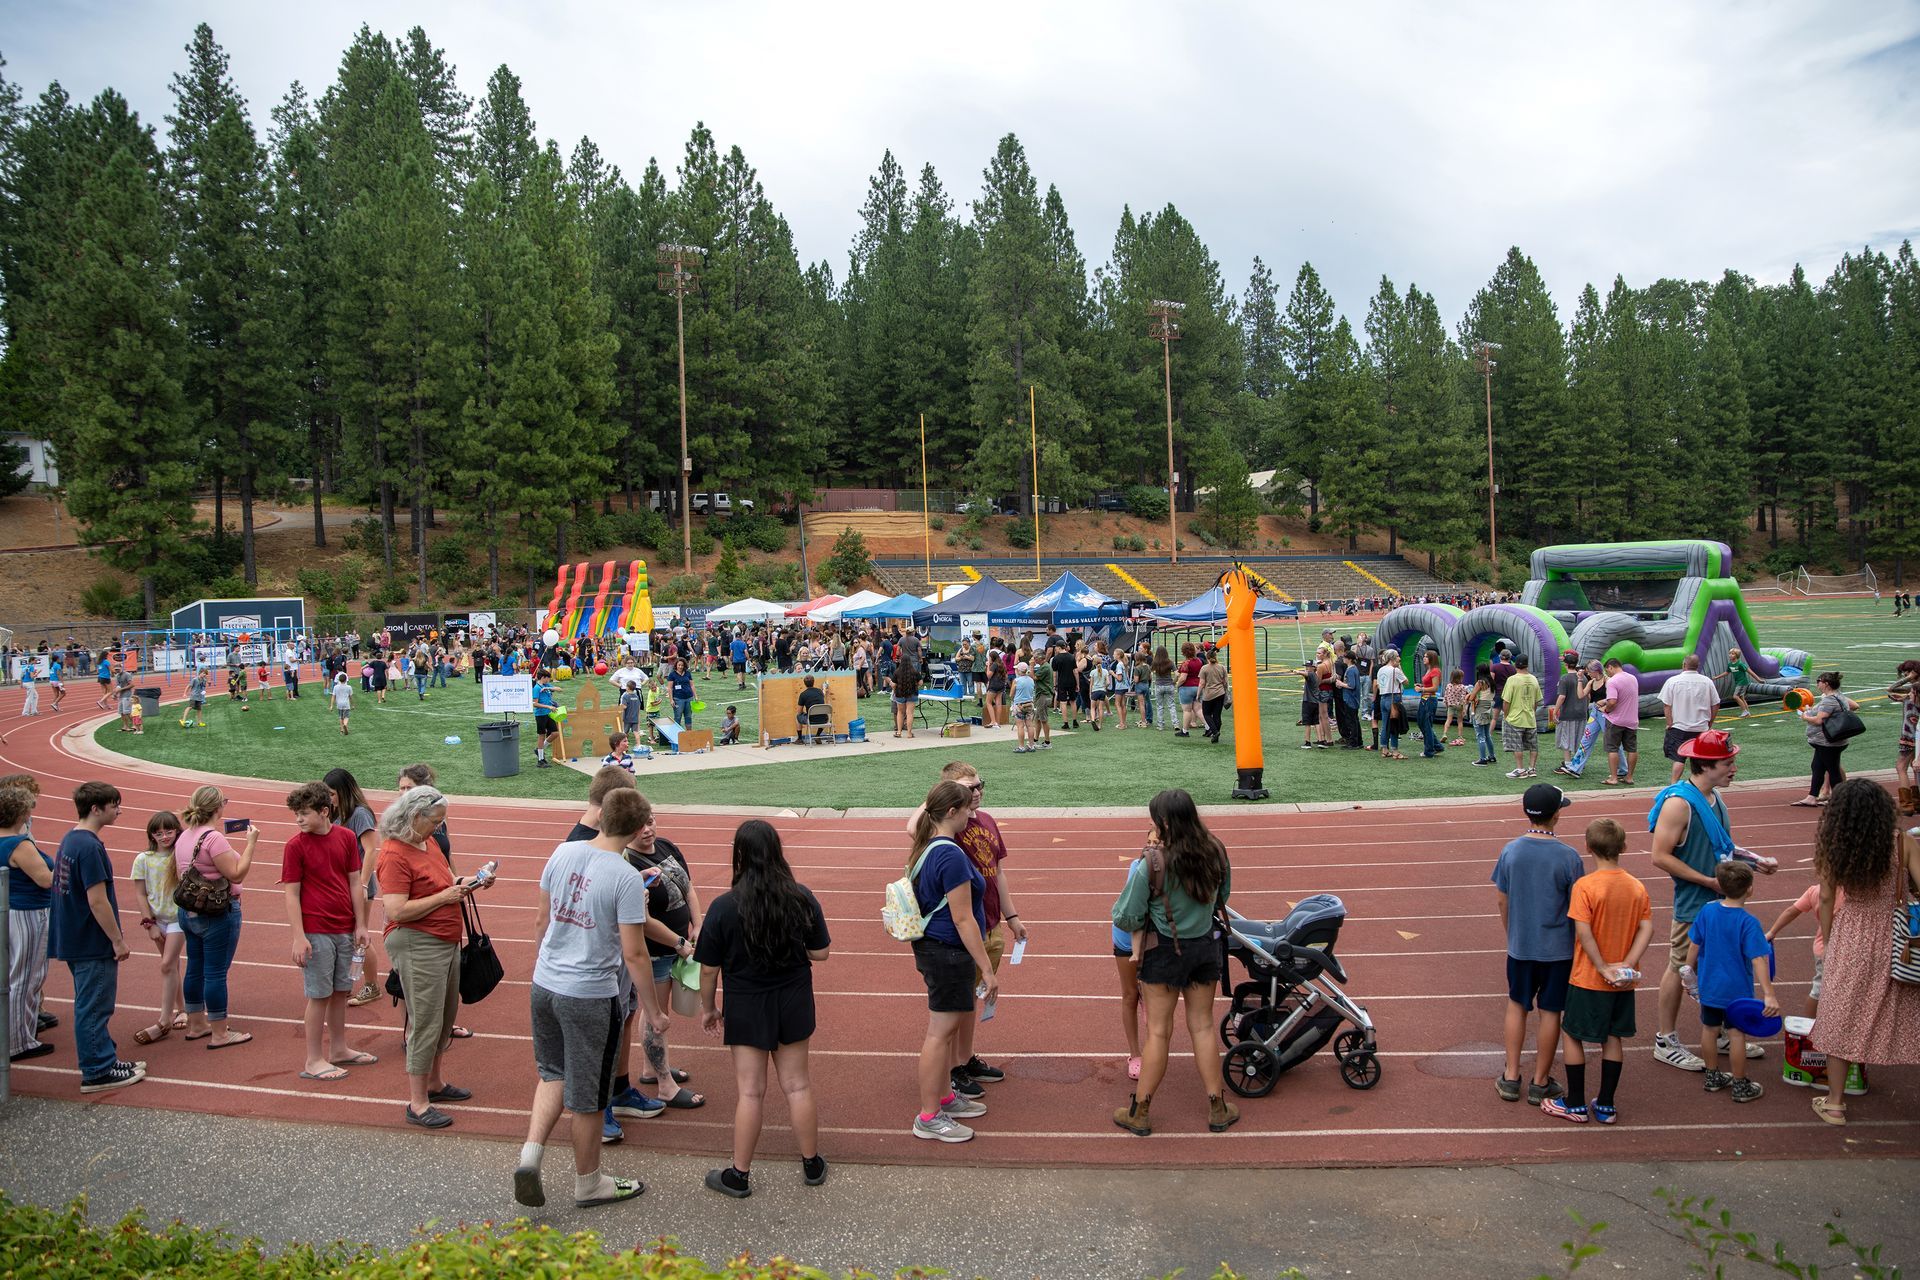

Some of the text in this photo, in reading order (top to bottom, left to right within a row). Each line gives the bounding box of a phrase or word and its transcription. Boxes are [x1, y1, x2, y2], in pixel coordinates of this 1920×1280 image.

[685, 607, 711, 615] Owens
[963, 826, 998, 846] HOGWARTS
[568, 872, 592, 892] PILE
